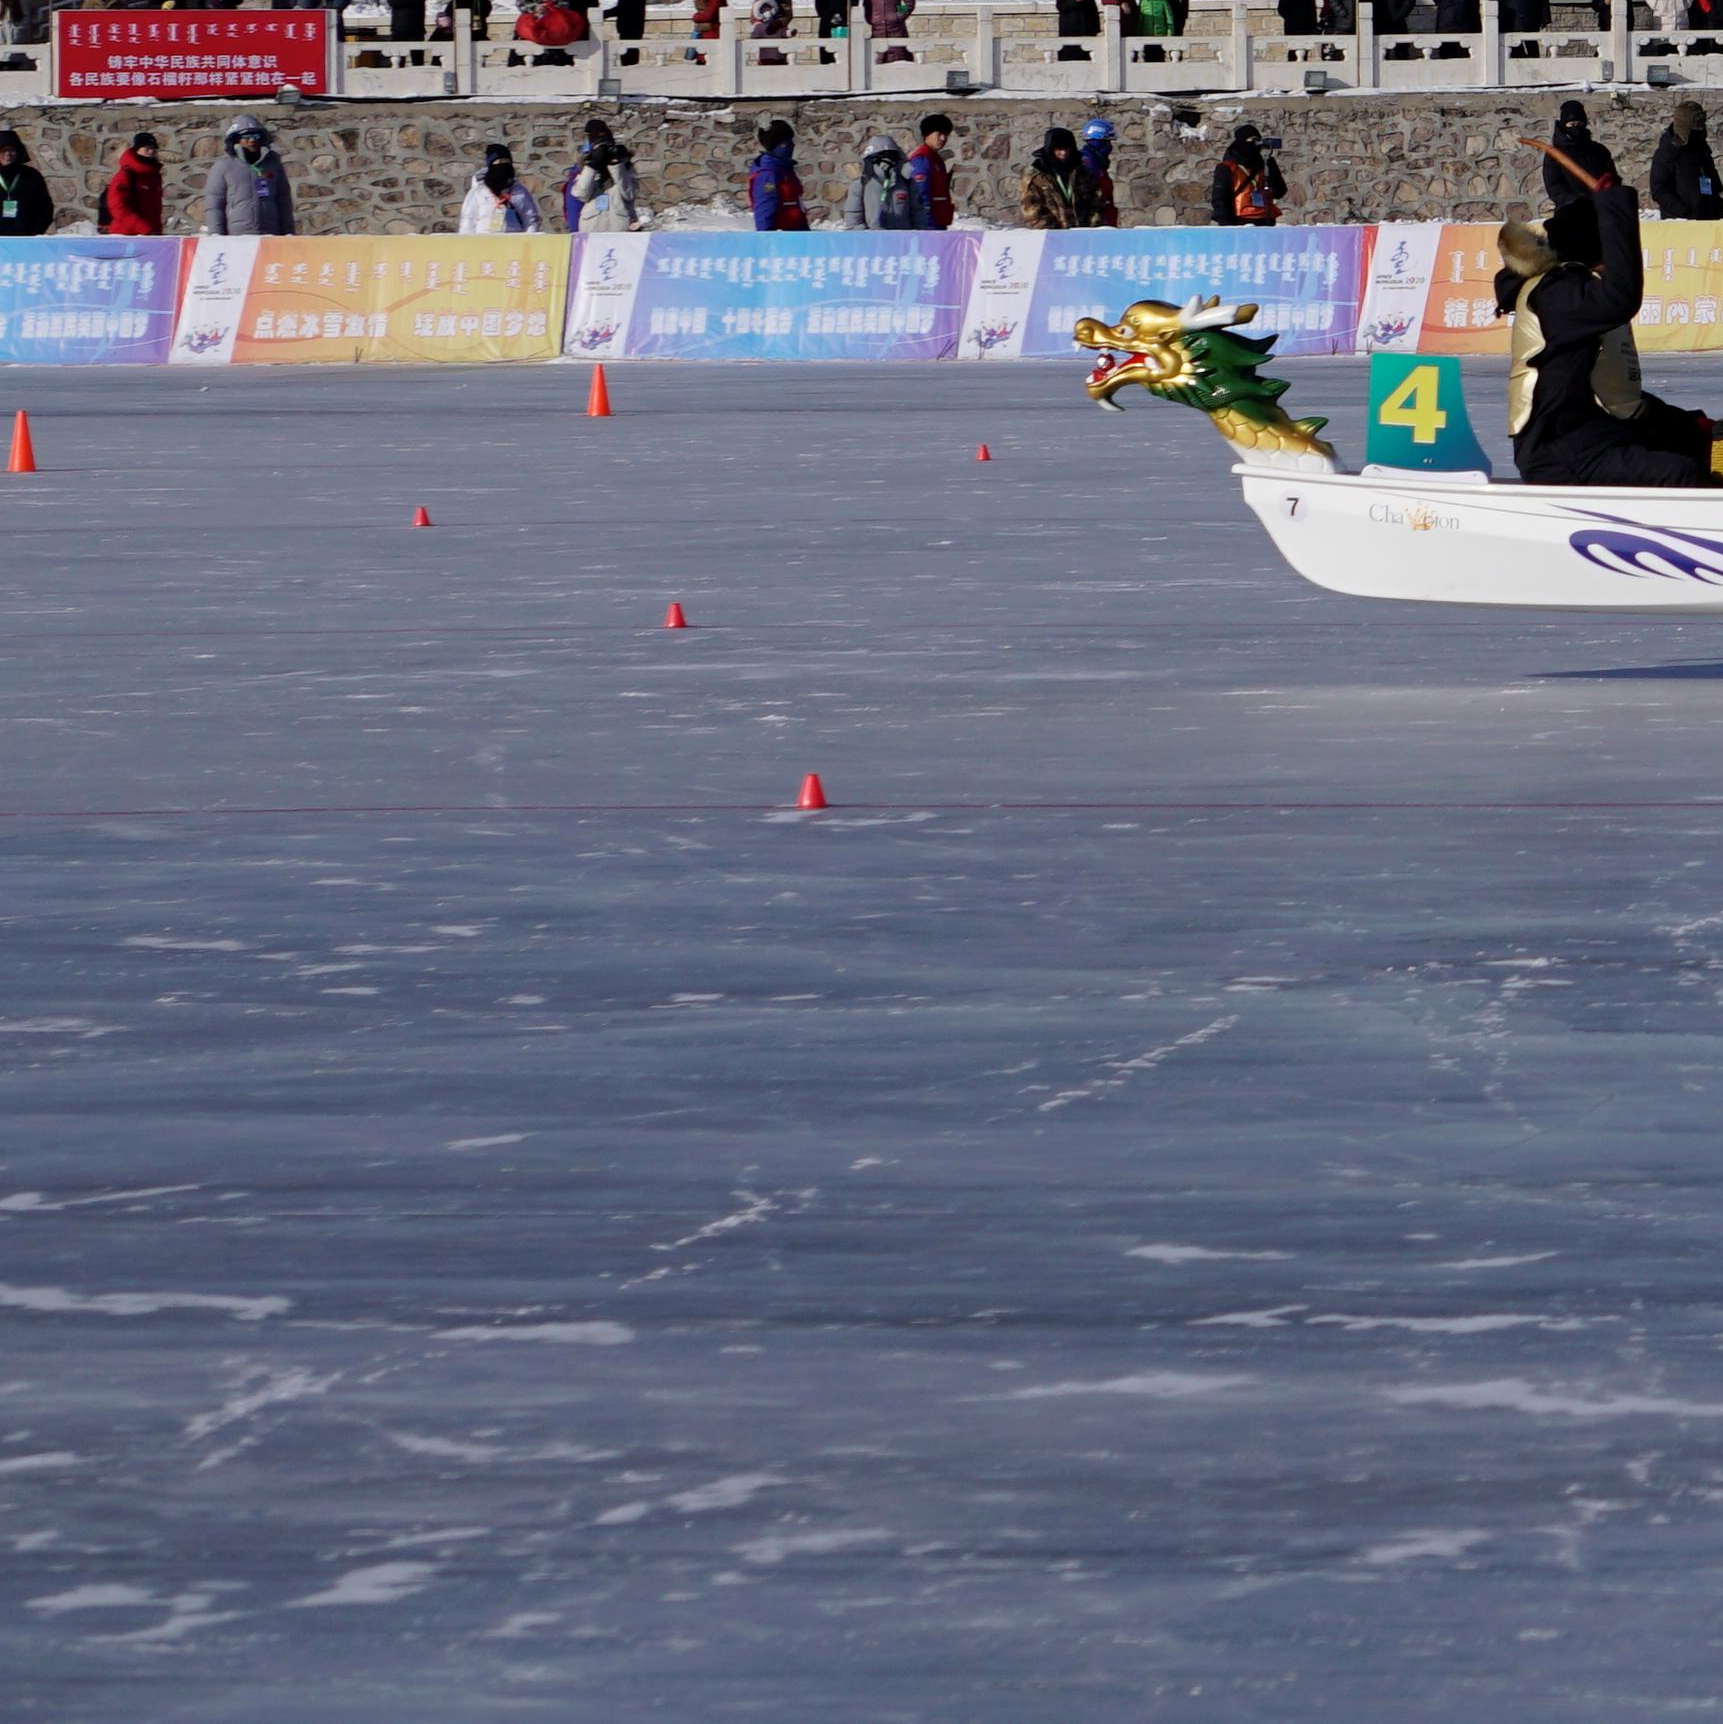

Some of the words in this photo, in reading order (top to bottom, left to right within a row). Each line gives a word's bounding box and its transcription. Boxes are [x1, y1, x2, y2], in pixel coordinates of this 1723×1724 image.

[106, 54, 279, 70] 铸牢中华民族共同体意识
[68, 71, 318, 87] 各民族要像石榴籽那样紧紧抱在一起
[252, 309, 389, 340] 点燃冰雪激情
[413, 308, 549, 339] 绽放中国梦想
[1378, 365, 1448, 444] 4
[1285, 497, 1300, 517] 7
